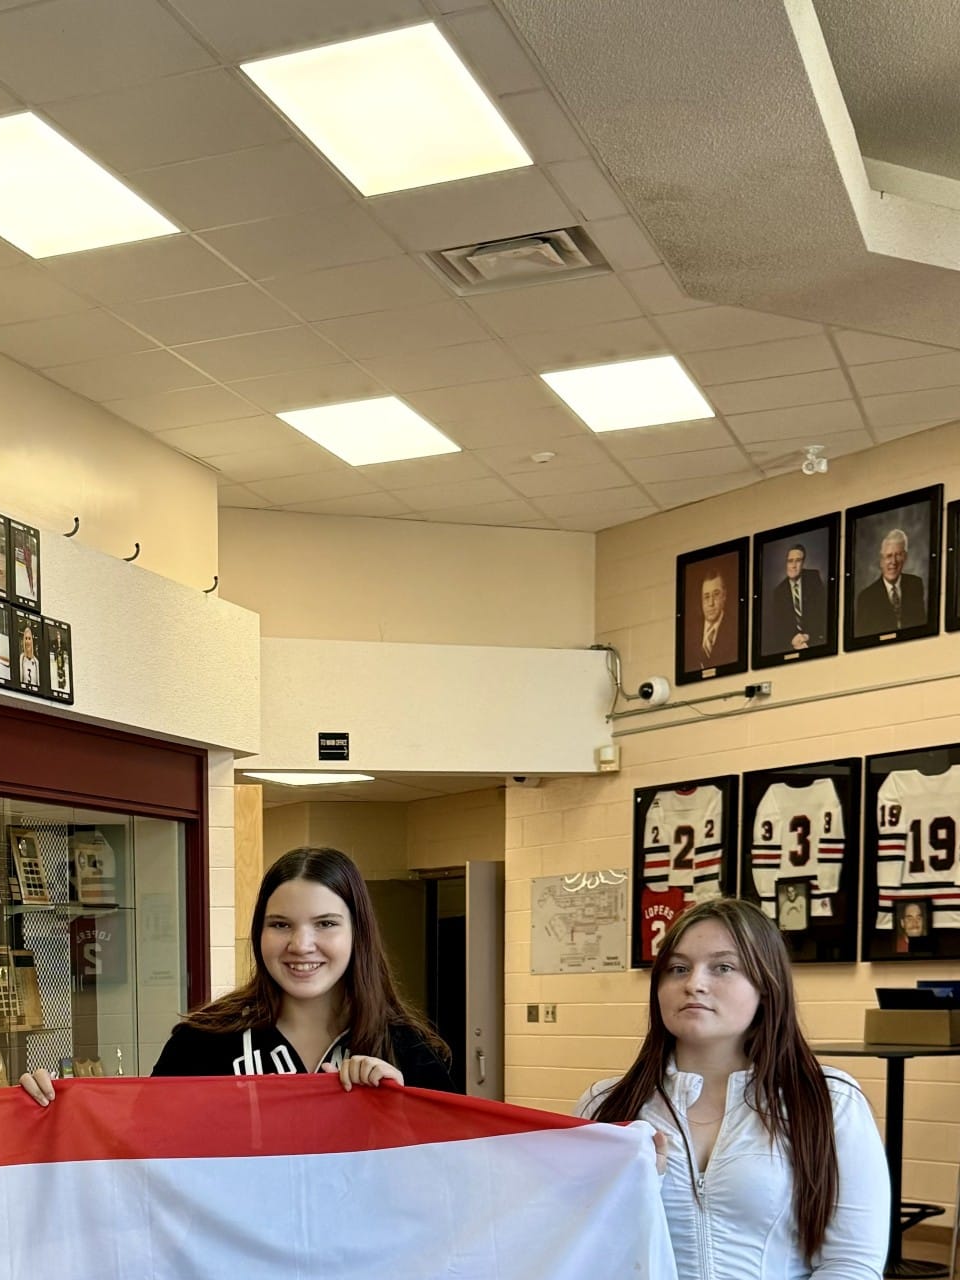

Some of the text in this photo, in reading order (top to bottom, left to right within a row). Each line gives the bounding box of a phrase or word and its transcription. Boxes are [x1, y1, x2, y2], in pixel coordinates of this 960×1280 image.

[879, 804, 902, 827] 19
[651, 826, 660, 843] 2
[704, 819, 714, 838] 2
[761, 820, 773, 841] 3
[672, 825, 695, 870] 2
[788, 814, 811, 867] 3
[909, 816, 956, 873] 19
[645, 904, 674, 921] LOPERS
[651, 920, 666, 957] 2
